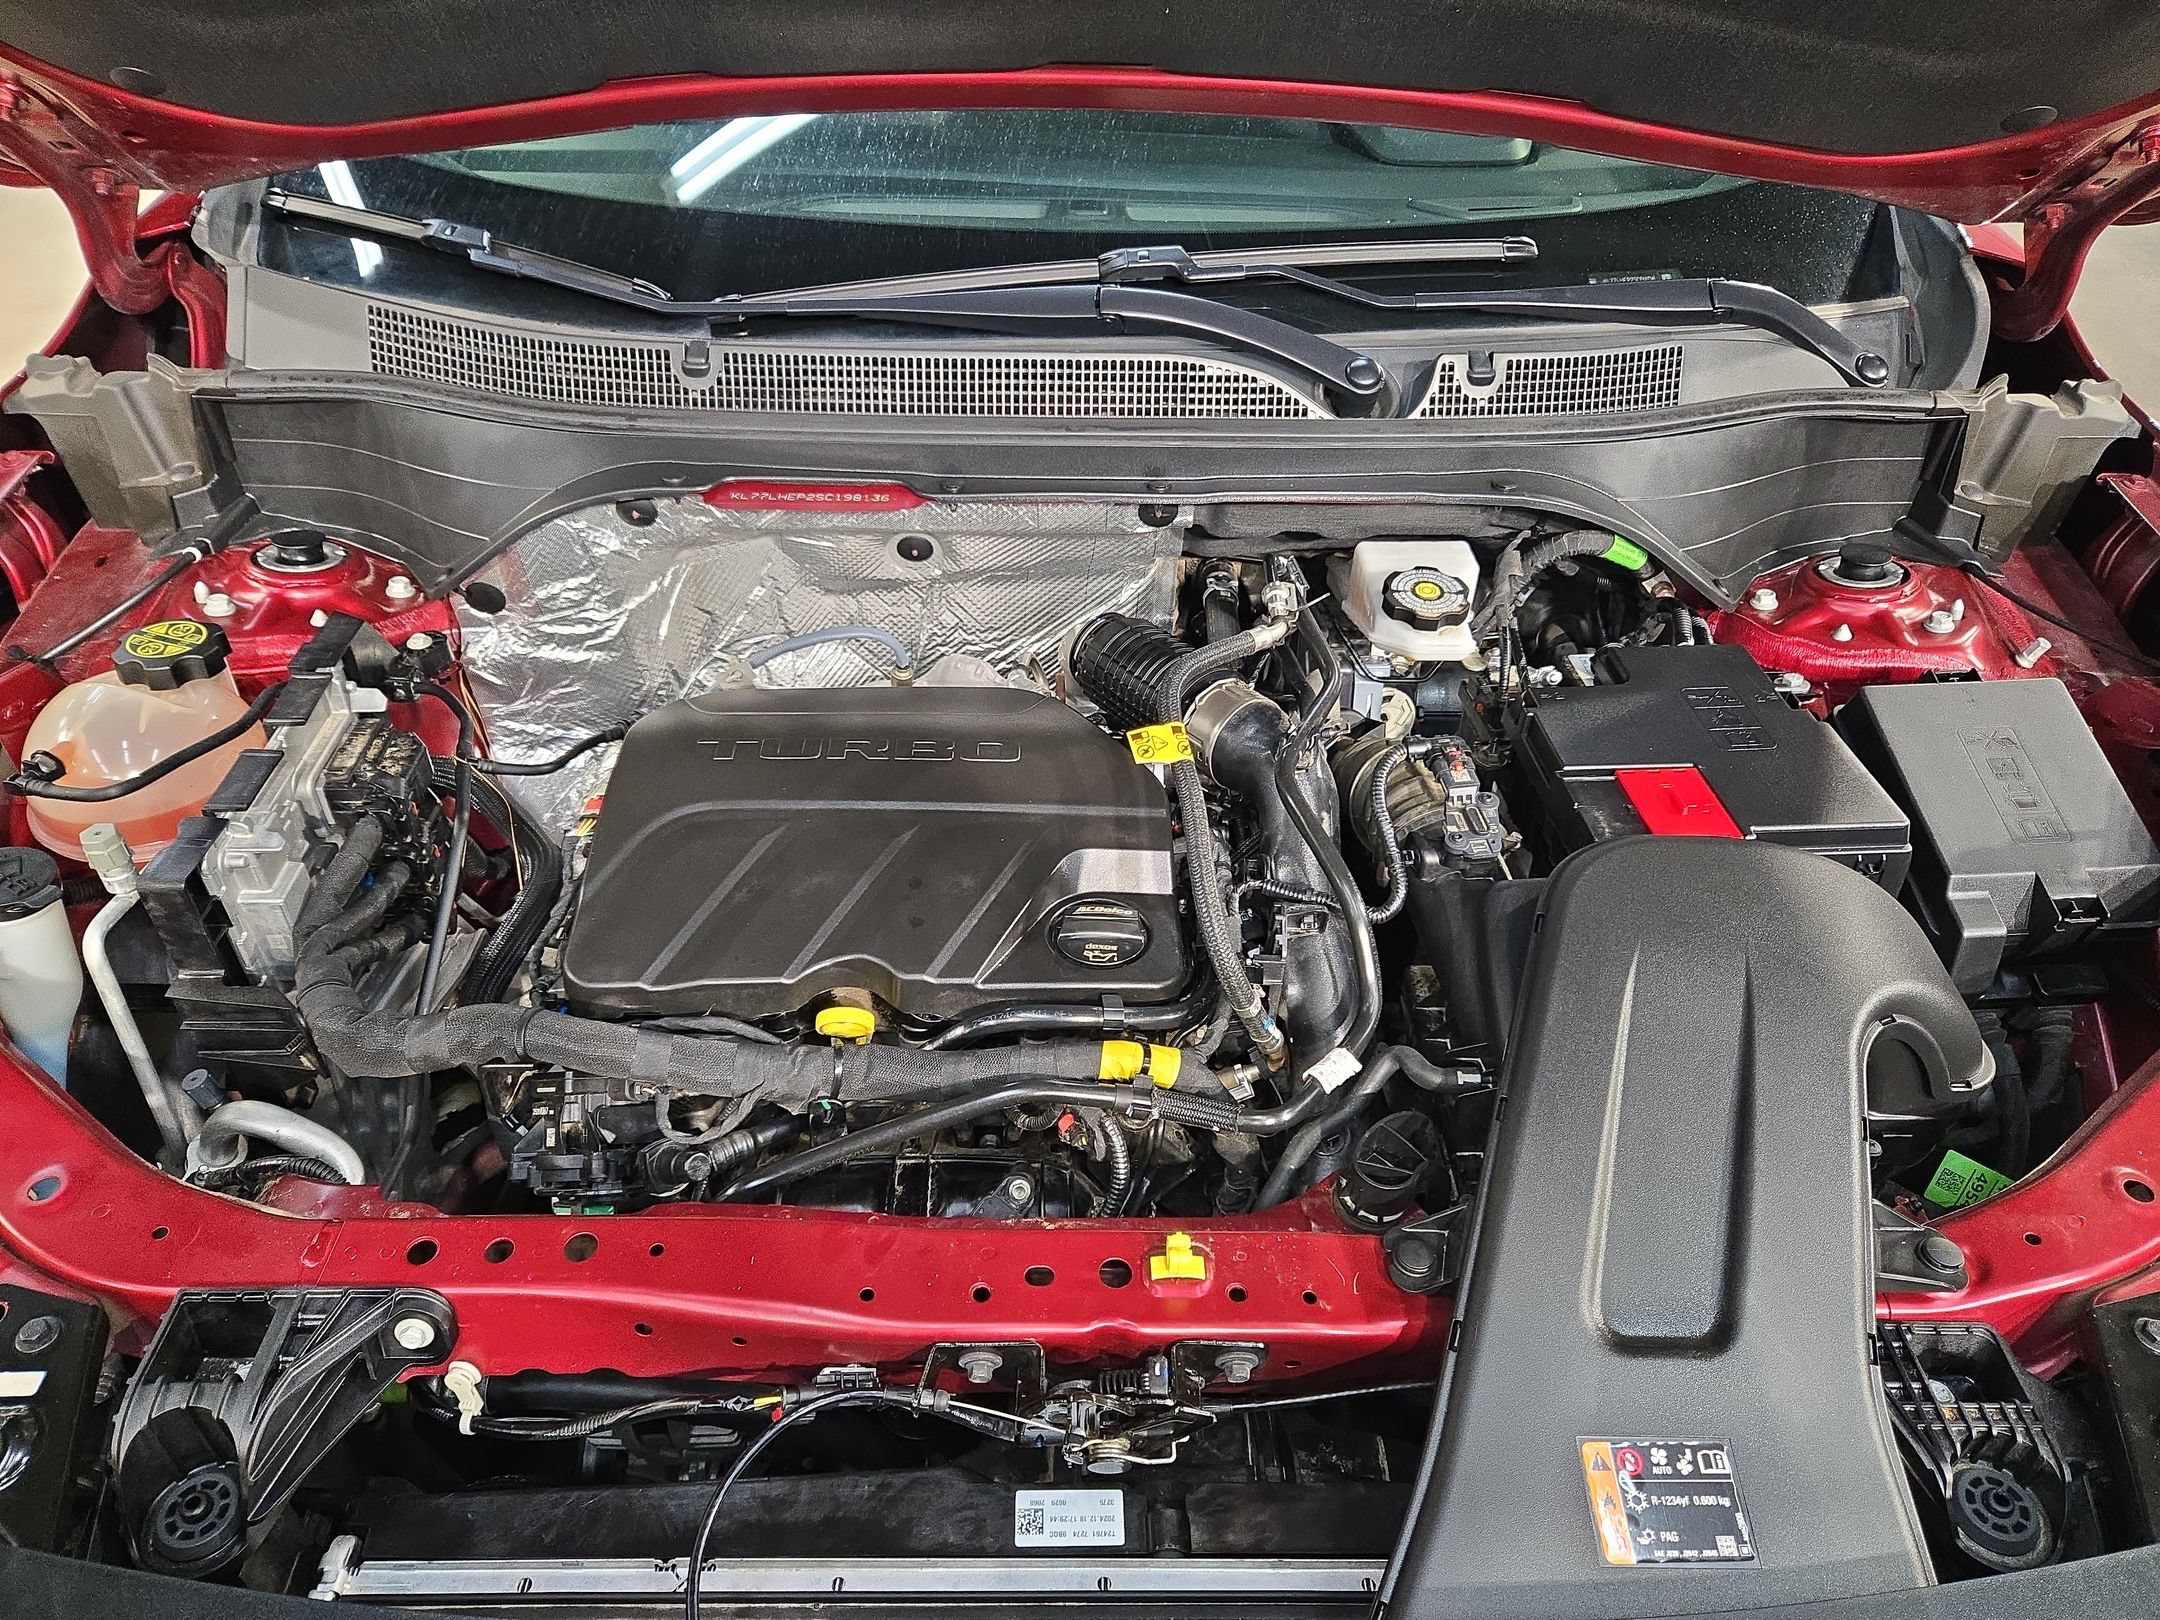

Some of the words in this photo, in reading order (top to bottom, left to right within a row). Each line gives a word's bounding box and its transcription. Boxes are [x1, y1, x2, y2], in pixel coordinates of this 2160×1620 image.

[697, 738, 1022, 762] TURBO
[1072, 906, 1134, 915] ACDelco
[1085, 943, 1118, 951] dexos
[1652, 1466, 1673, 1475] AUTO
[1651, 1495, 1690, 1507] R-1234yf
[1693, 1495, 1716, 1506] 0.600
[1717, 1496, 1731, 1508] kg
[1660, 1531, 1680, 1543] PAG
